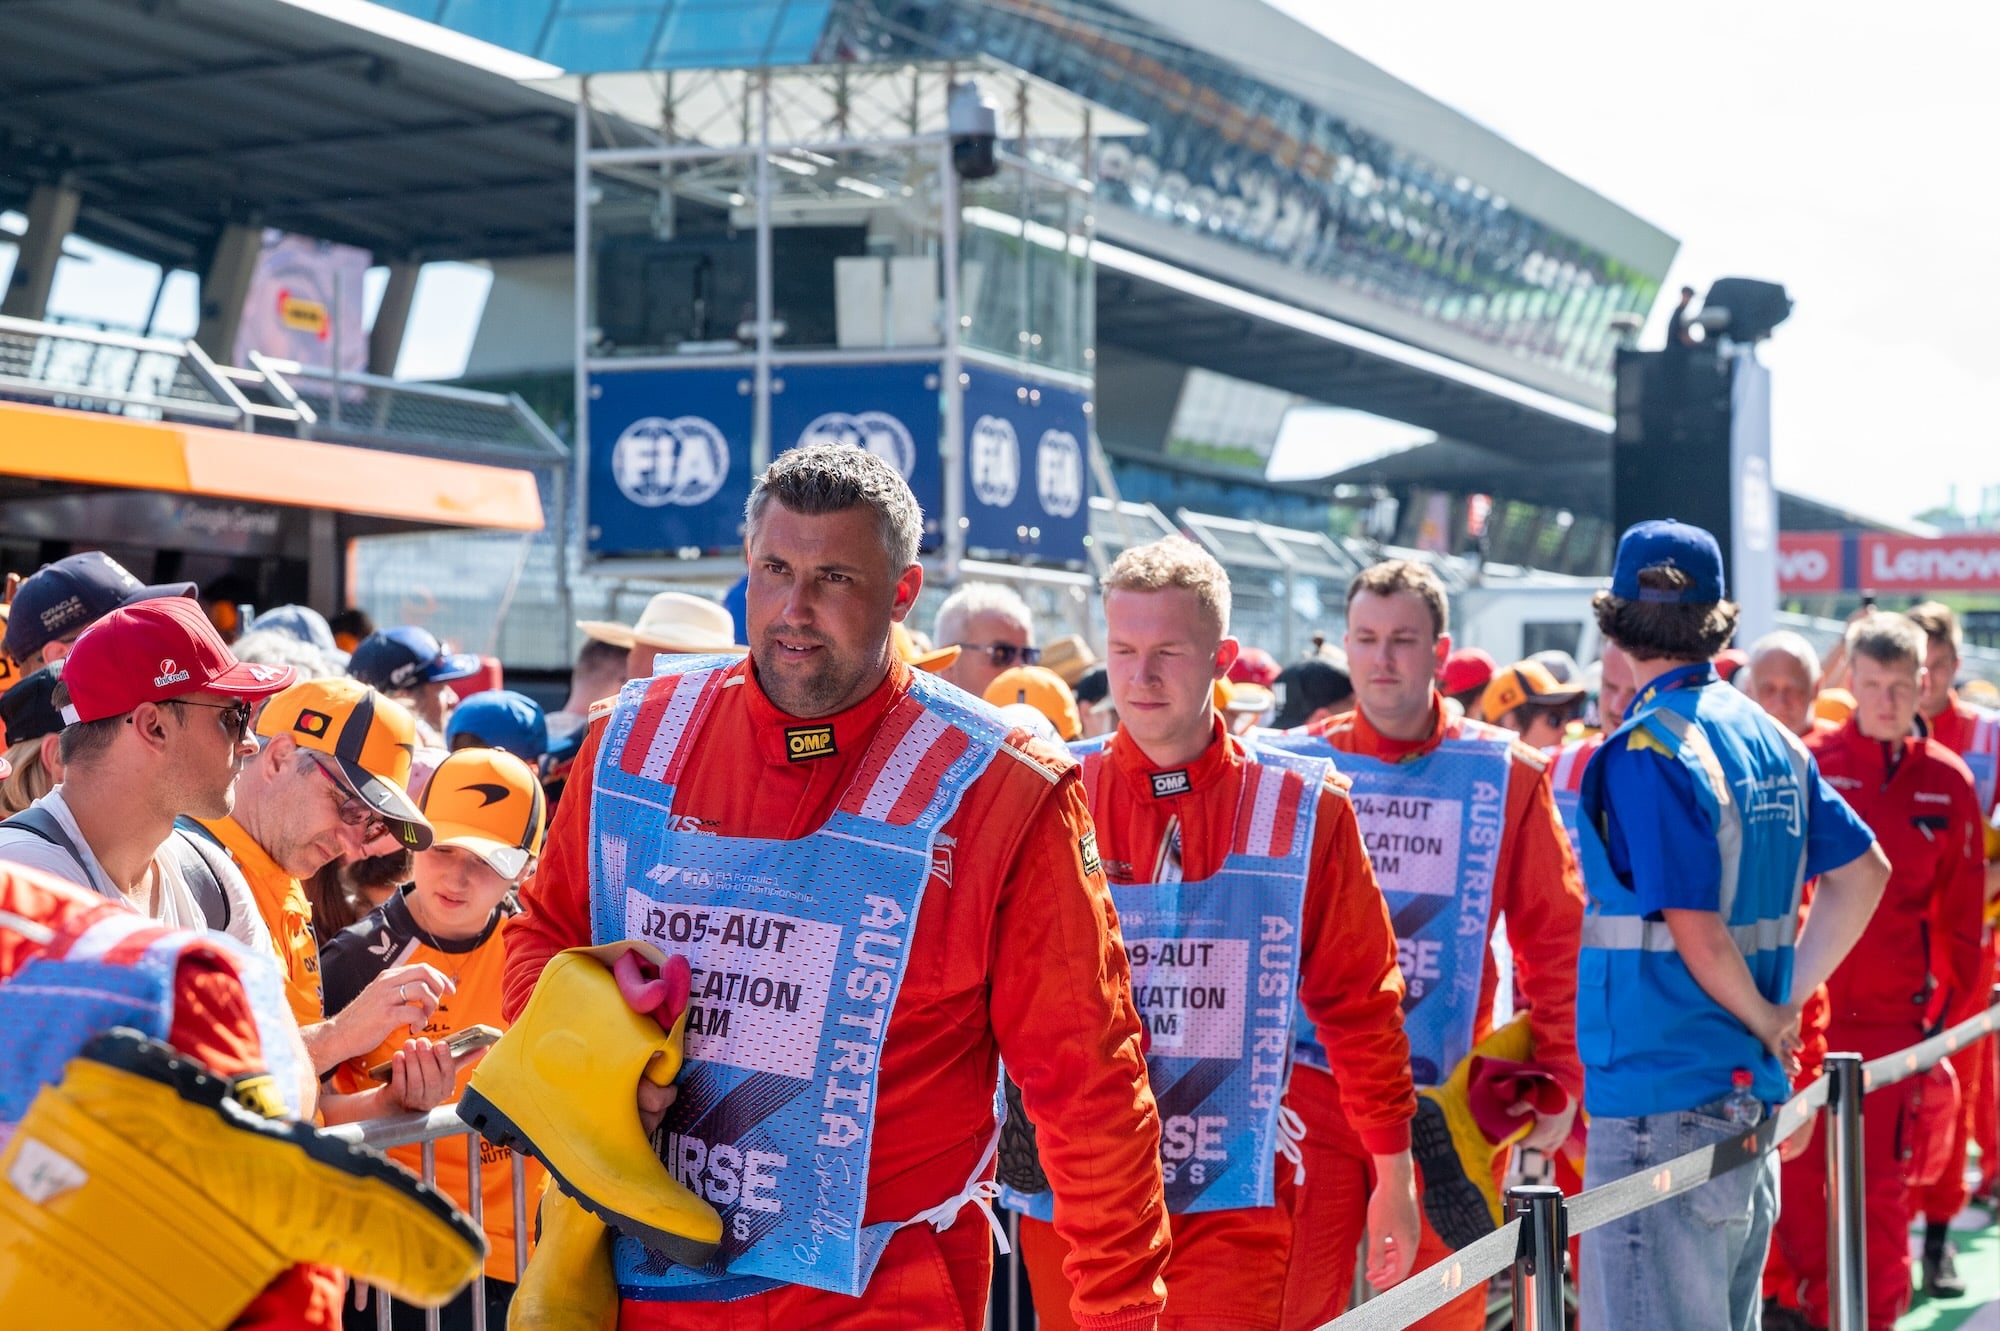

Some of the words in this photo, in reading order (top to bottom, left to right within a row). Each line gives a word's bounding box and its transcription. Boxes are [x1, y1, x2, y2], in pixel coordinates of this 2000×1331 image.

[622, 434, 717, 487] FIA
[972, 433, 1017, 484] FIA
[1039, 447, 1078, 498] FIA
[154, 670, 190, 688] UniCredit
[249, 664, 284, 683] 44
[607, 710, 635, 767] ACCESS
[790, 733, 831, 753] OMP
[1155, 775, 1187, 791] OMP
[716, 872, 733, 882] FIA
[734, 873, 772, 885] Formula
[1456, 780, 1499, 936] AUSTRIA
[817, 894, 906, 1148] AUSTRIA
[1250, 915, 1294, 1109] AUSTRIA
[793, 1152, 851, 1267] Spielberg
